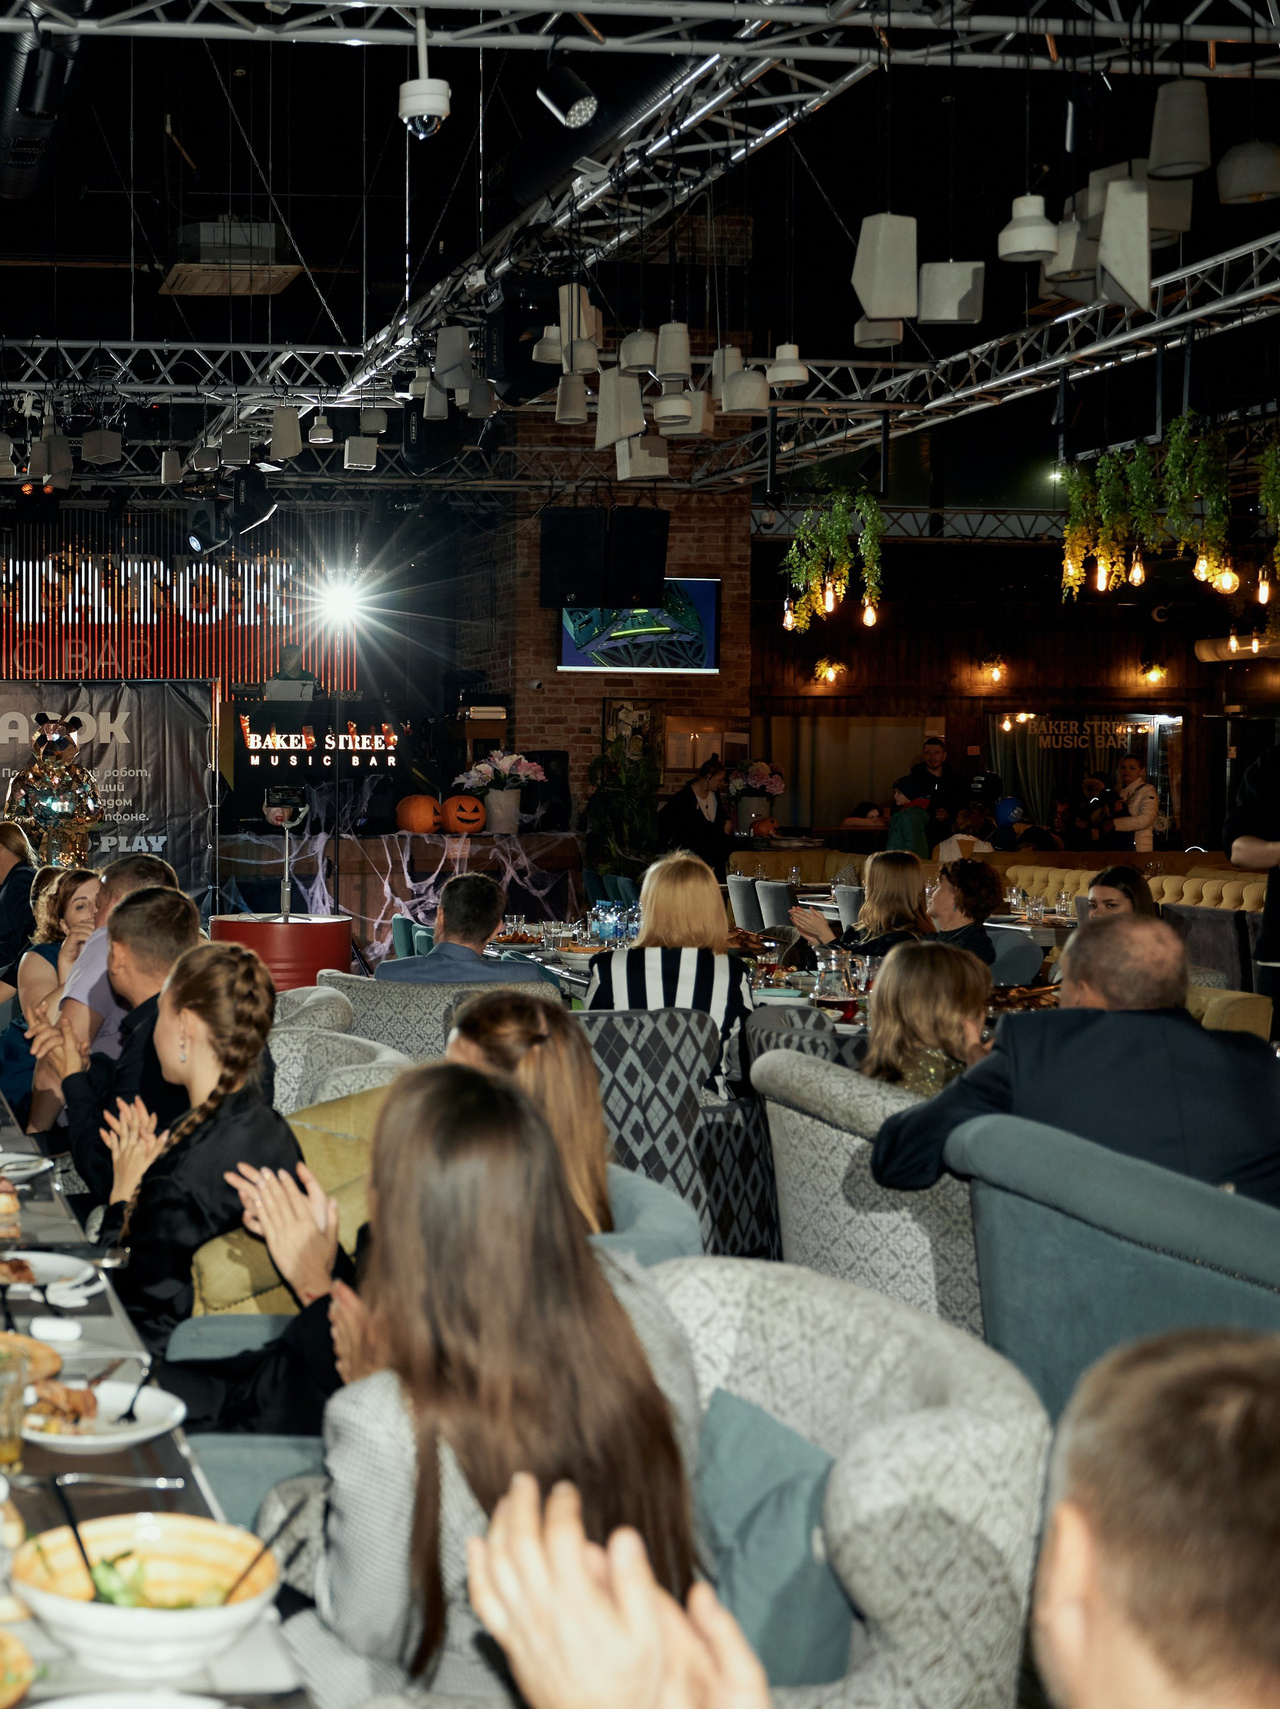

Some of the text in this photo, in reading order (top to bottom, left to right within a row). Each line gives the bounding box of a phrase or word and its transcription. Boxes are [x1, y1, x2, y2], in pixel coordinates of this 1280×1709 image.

[64, 639, 153, 676] BAR
[1028, 720, 1079, 735] BAKER
[1038, 735, 1127, 749] MUSIC BAR
[250, 755, 396, 766] MUSIC BAR
[104, 767, 152, 779] робот,
[89, 835, 168, 854] -PLAY
